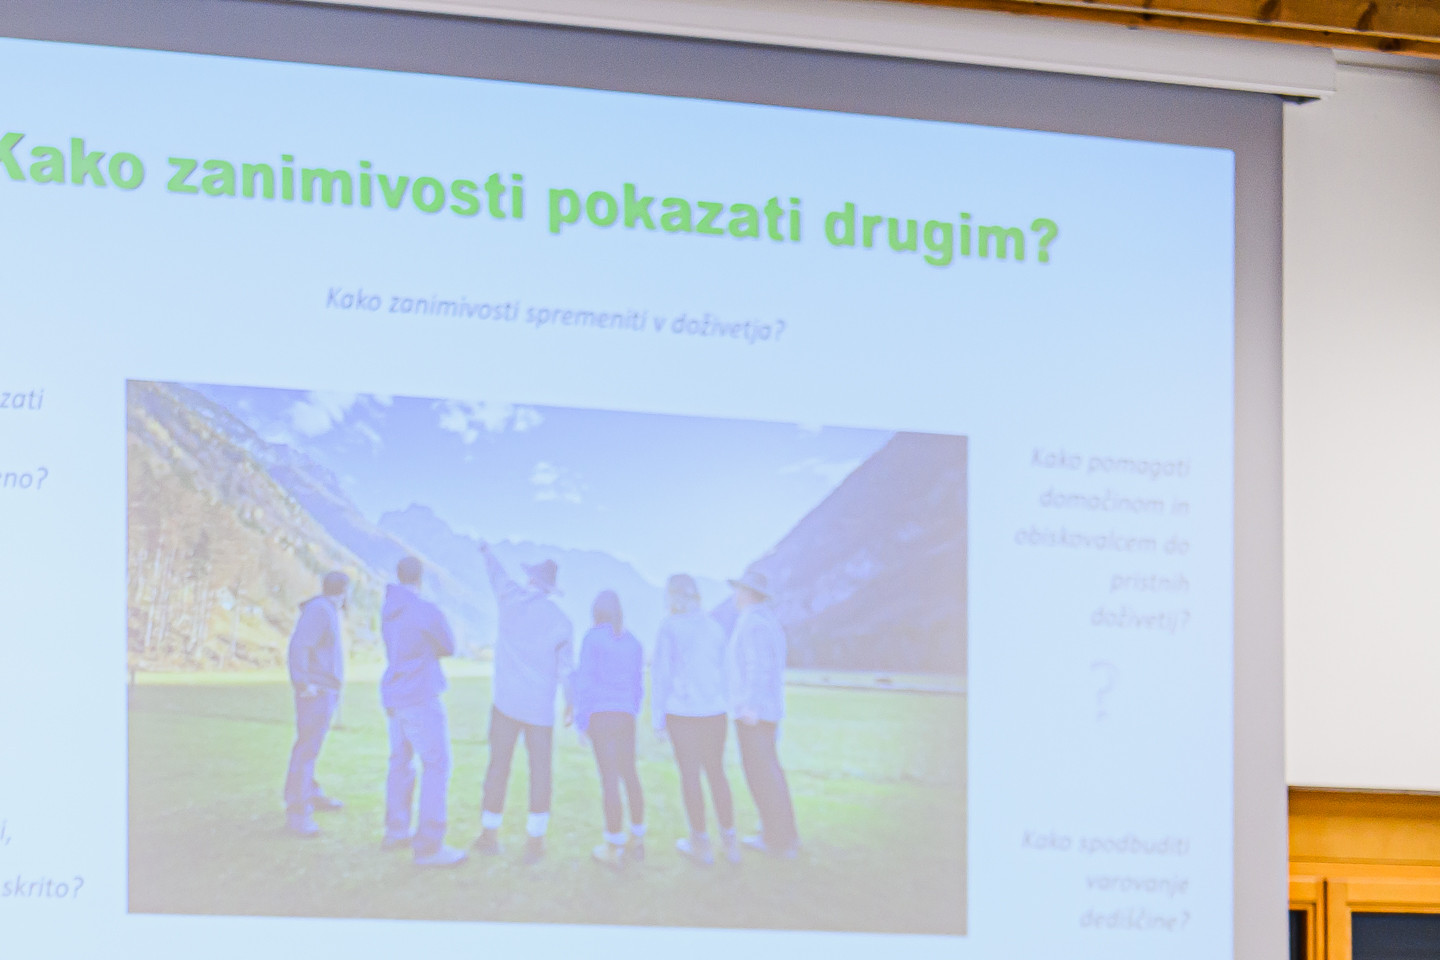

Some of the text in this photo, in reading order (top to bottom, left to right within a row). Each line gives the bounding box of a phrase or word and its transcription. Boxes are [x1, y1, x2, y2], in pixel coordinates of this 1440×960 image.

[165, 153, 524, 221] zanimivosti
[548, 182, 802, 243] pokazati
[824, 201, 1060, 268] drugim?
[325, 286, 786, 345] Kako zanimivosti spremeniti v doživetja?
[1031, 447, 1082, 471] Kako
[1, 875, 85, 899] skrito?
